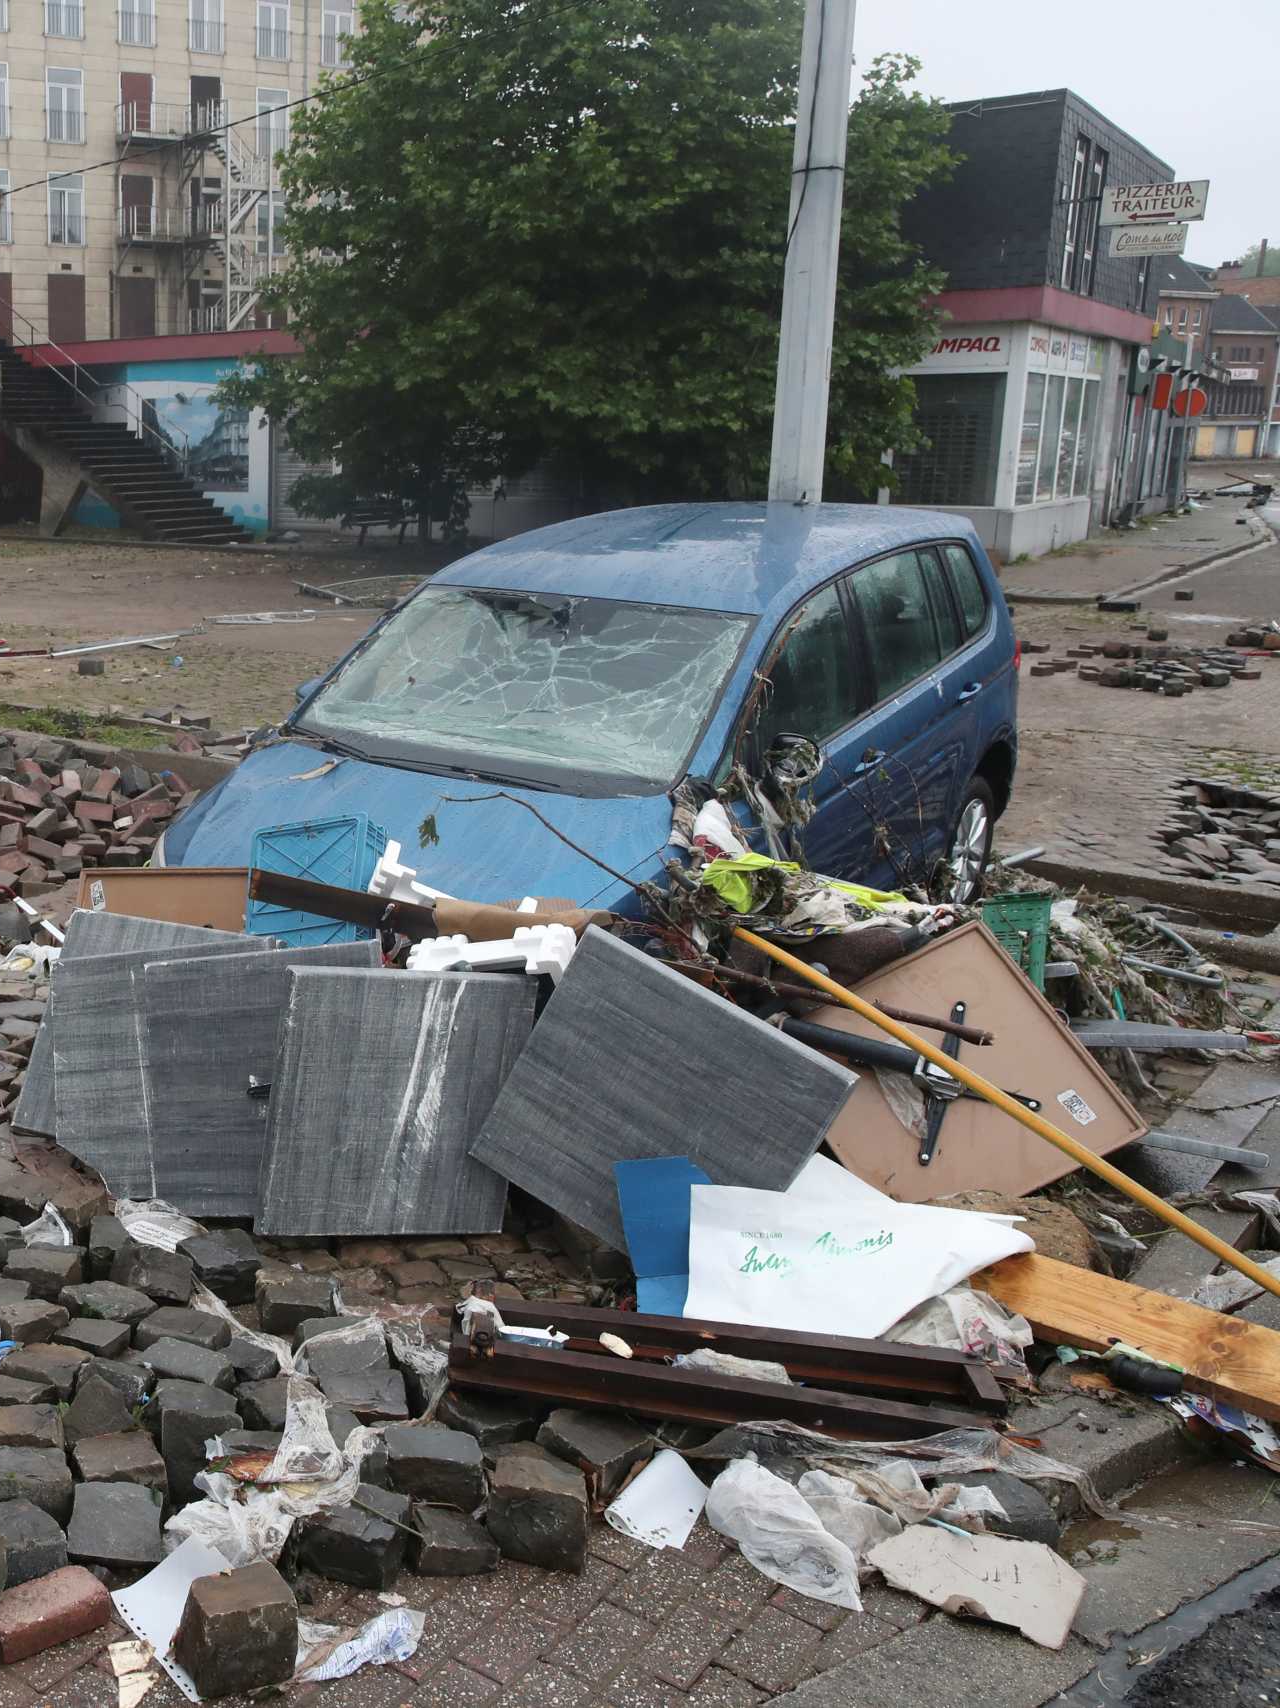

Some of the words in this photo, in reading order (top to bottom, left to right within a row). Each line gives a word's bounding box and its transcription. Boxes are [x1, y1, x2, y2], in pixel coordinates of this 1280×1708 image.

[1116, 183, 1193, 199] PIZZERIA
[1112, 196, 1195, 213] TRAITEUR
[931, 336, 1001, 354] MPAQ
